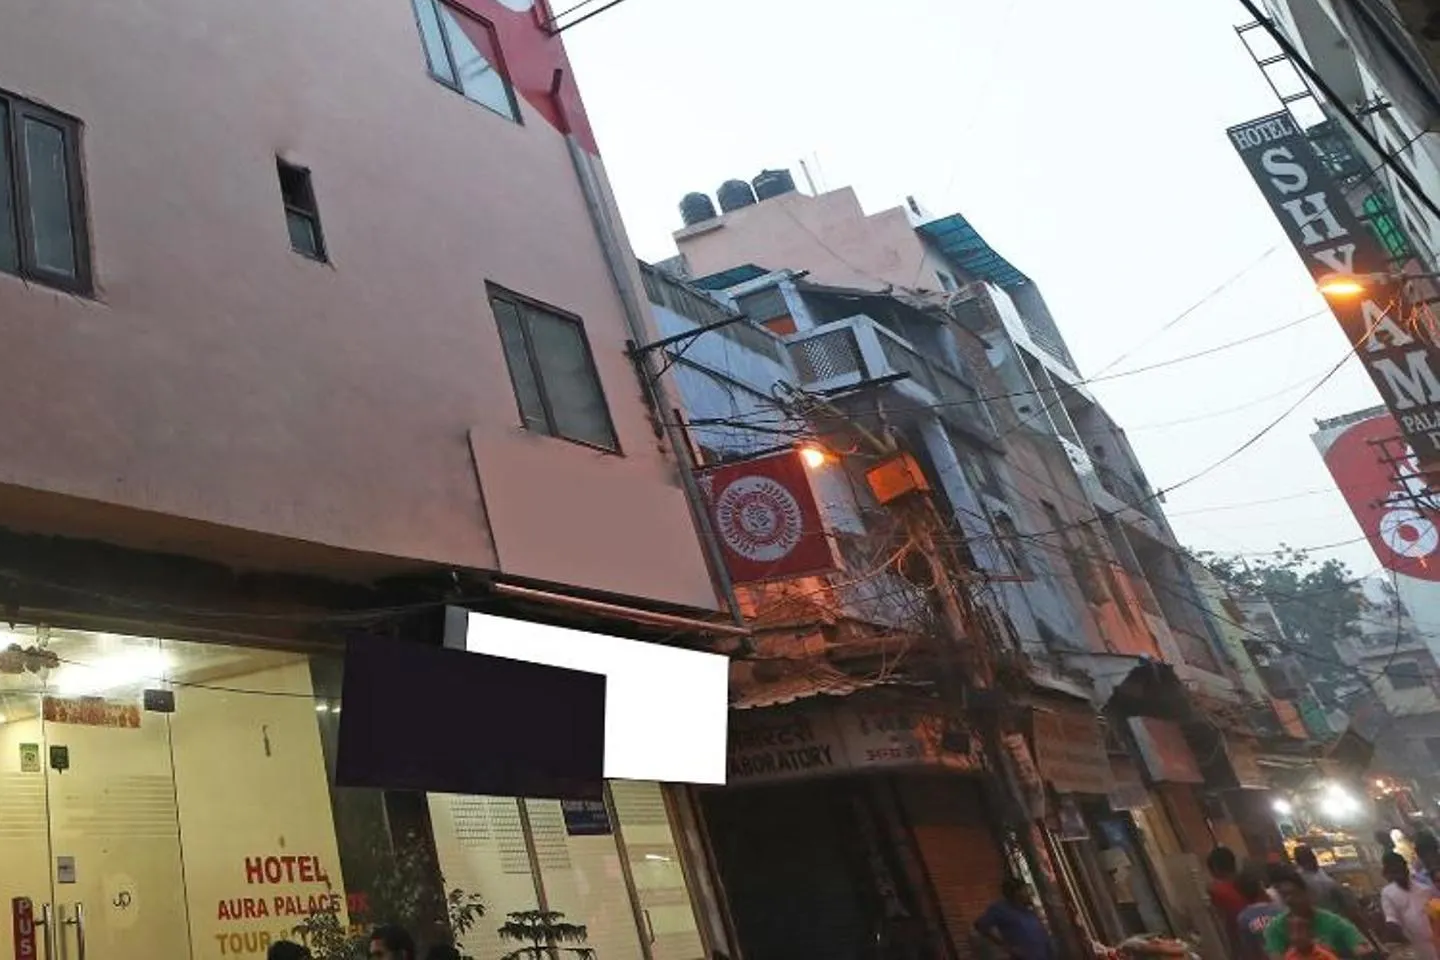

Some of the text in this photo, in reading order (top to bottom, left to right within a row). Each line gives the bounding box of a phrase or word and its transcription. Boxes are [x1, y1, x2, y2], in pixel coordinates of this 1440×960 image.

[1232, 116, 1295, 151] HOTEL
[729, 744, 835, 778] ABORATORY
[245, 855, 329, 884] HOTEL
[218, 898, 269, 921] AURA
[273, 893, 342, 917] PALACE
